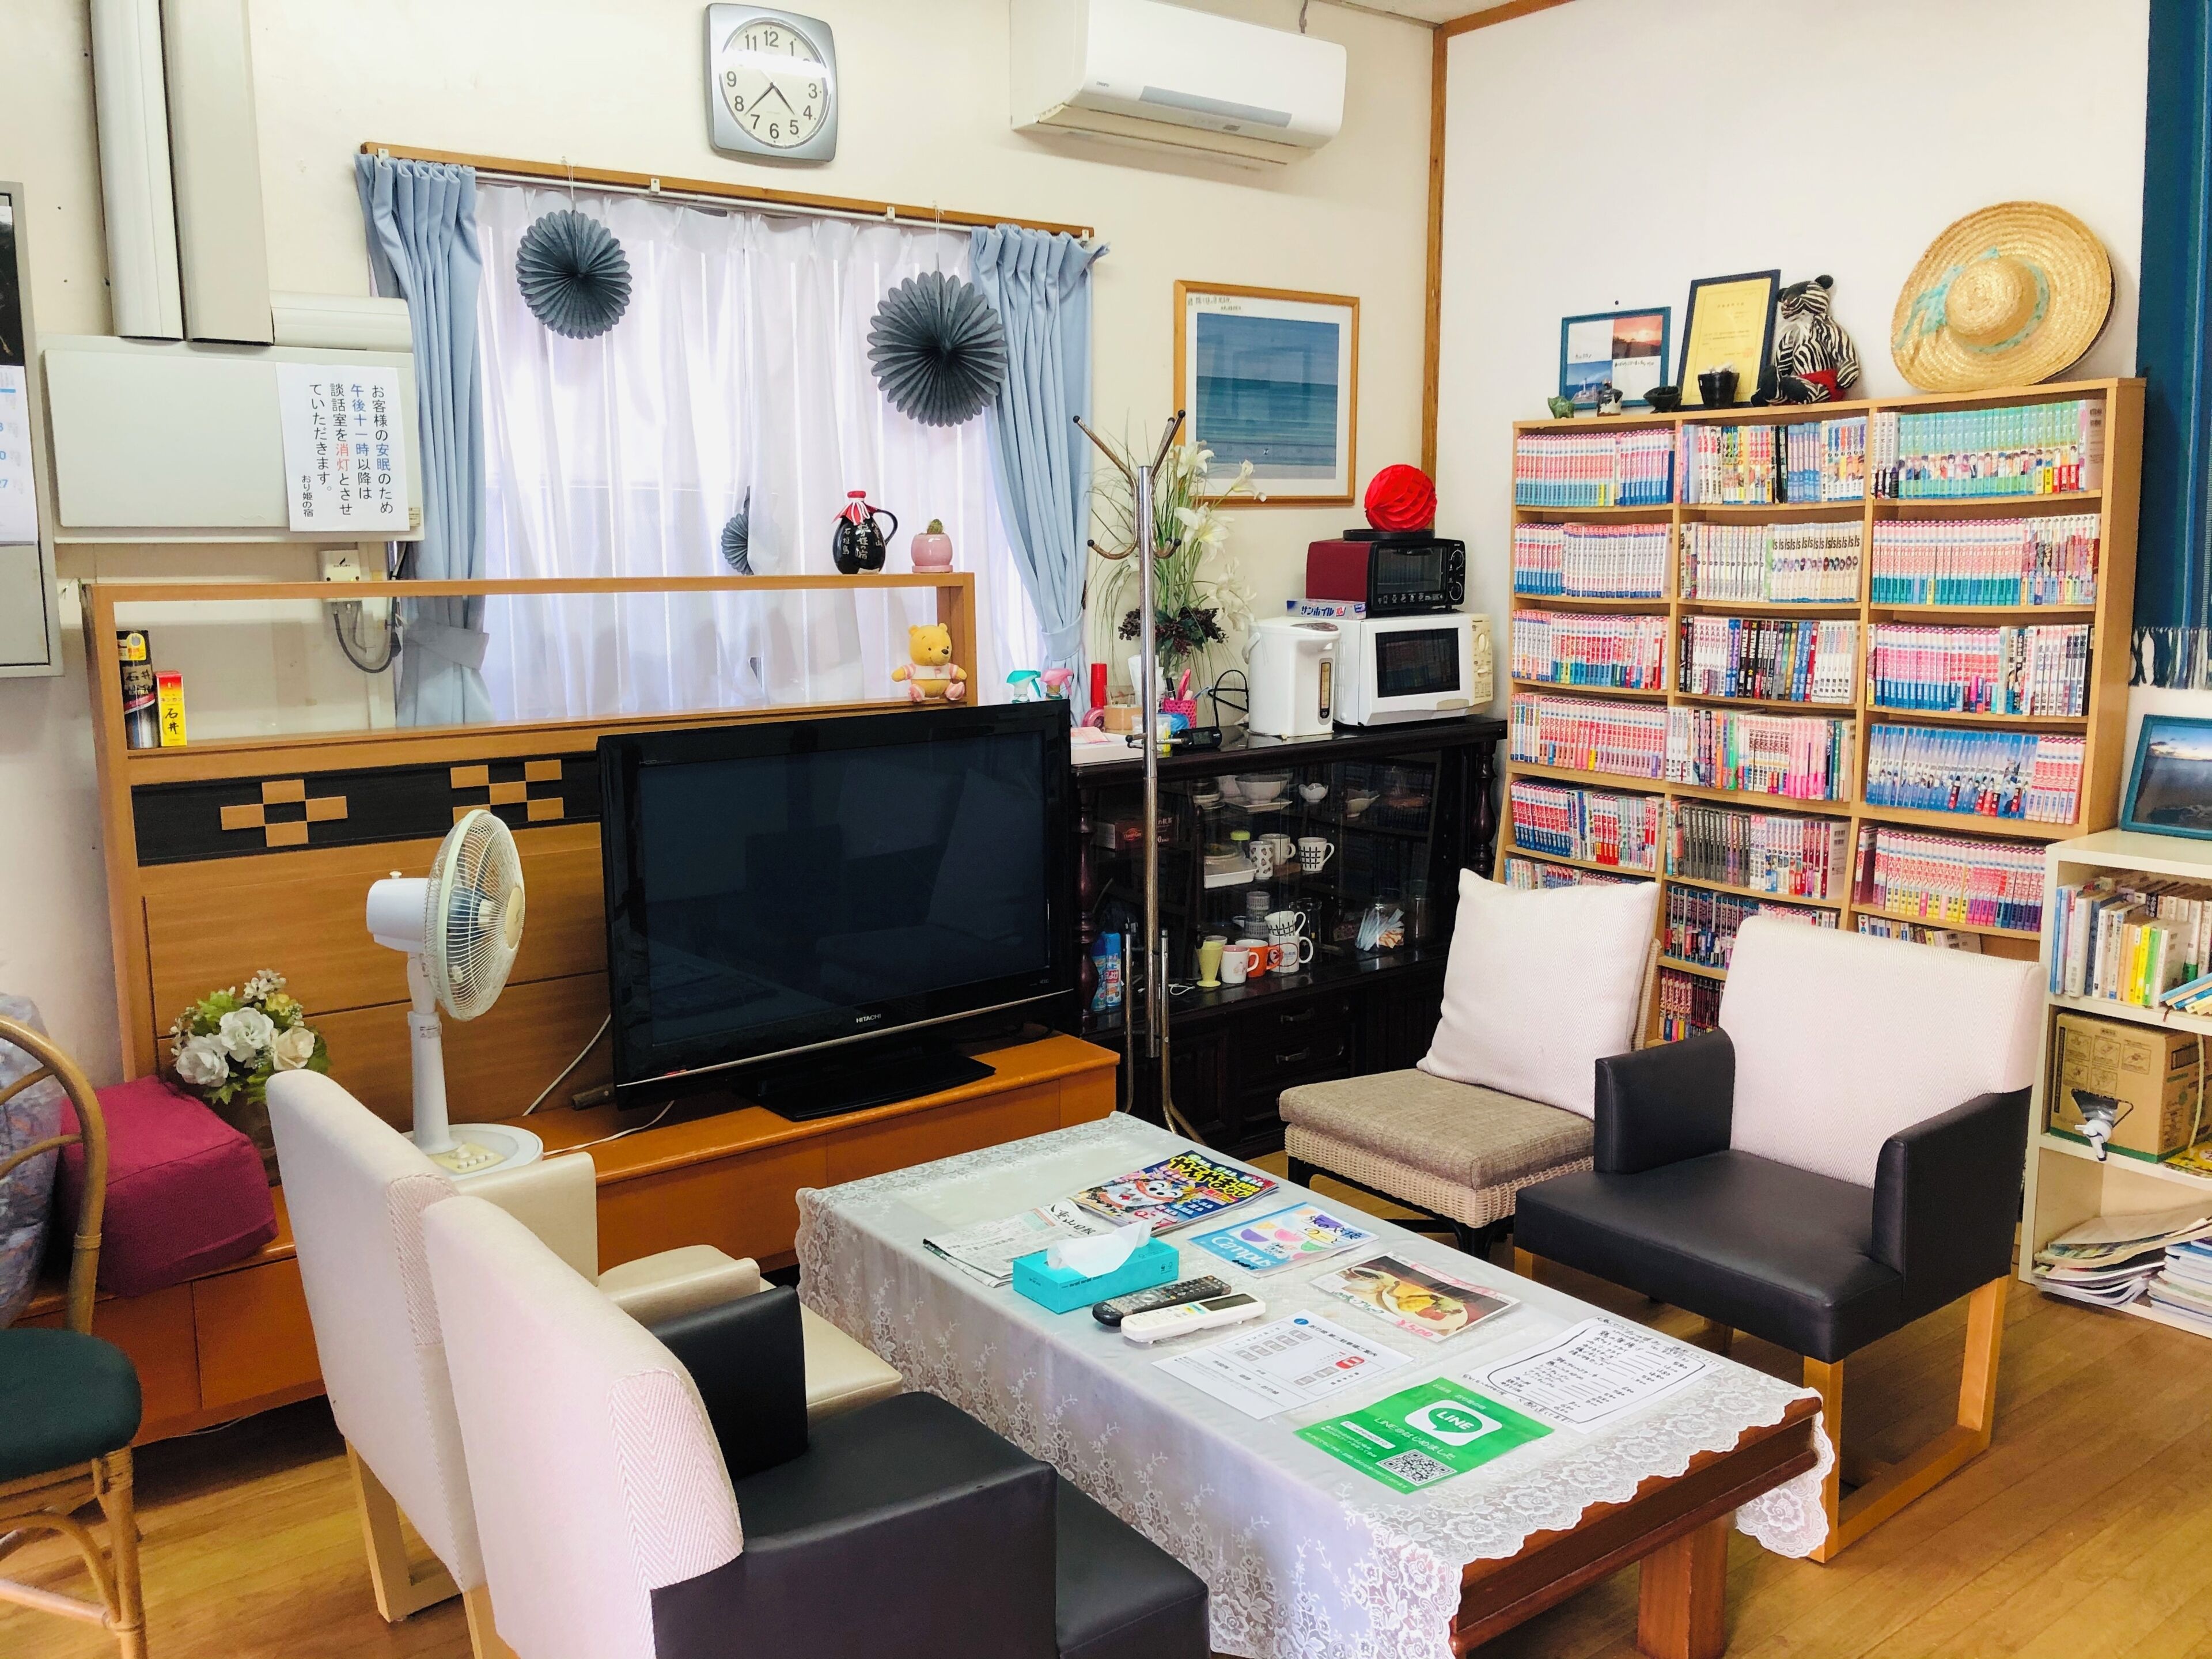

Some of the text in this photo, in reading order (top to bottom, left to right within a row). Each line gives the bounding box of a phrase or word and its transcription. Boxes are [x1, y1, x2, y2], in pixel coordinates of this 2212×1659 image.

[745, 34, 756, 51] 11
[764, 30, 779, 47] 12
[790, 40, 794, 56] 1
[726, 71, 737, 87] 9
[808, 83, 817, 99] 3
[734, 96, 744, 112] 8
[803, 105, 813, 120] 4
[751, 114, 760, 130] 7
[790, 120, 799, 135] 5
[770, 123, 779, 139] 6
[309, 384, 332, 491] ていただきます。
[350, 384, 372, 499] 午後十一時以降は
[329, 383, 353, 516] 談話室を消灯とさせ
[372, 385, 393, 514] お客様の安眠のため
[301, 475, 313, 517] おり姫の宿
[856, 1014, 881, 1023] HITACHI
[1211, 1237, 1277, 1267] Campus
[1436, 1411, 1474, 1430] LINE
